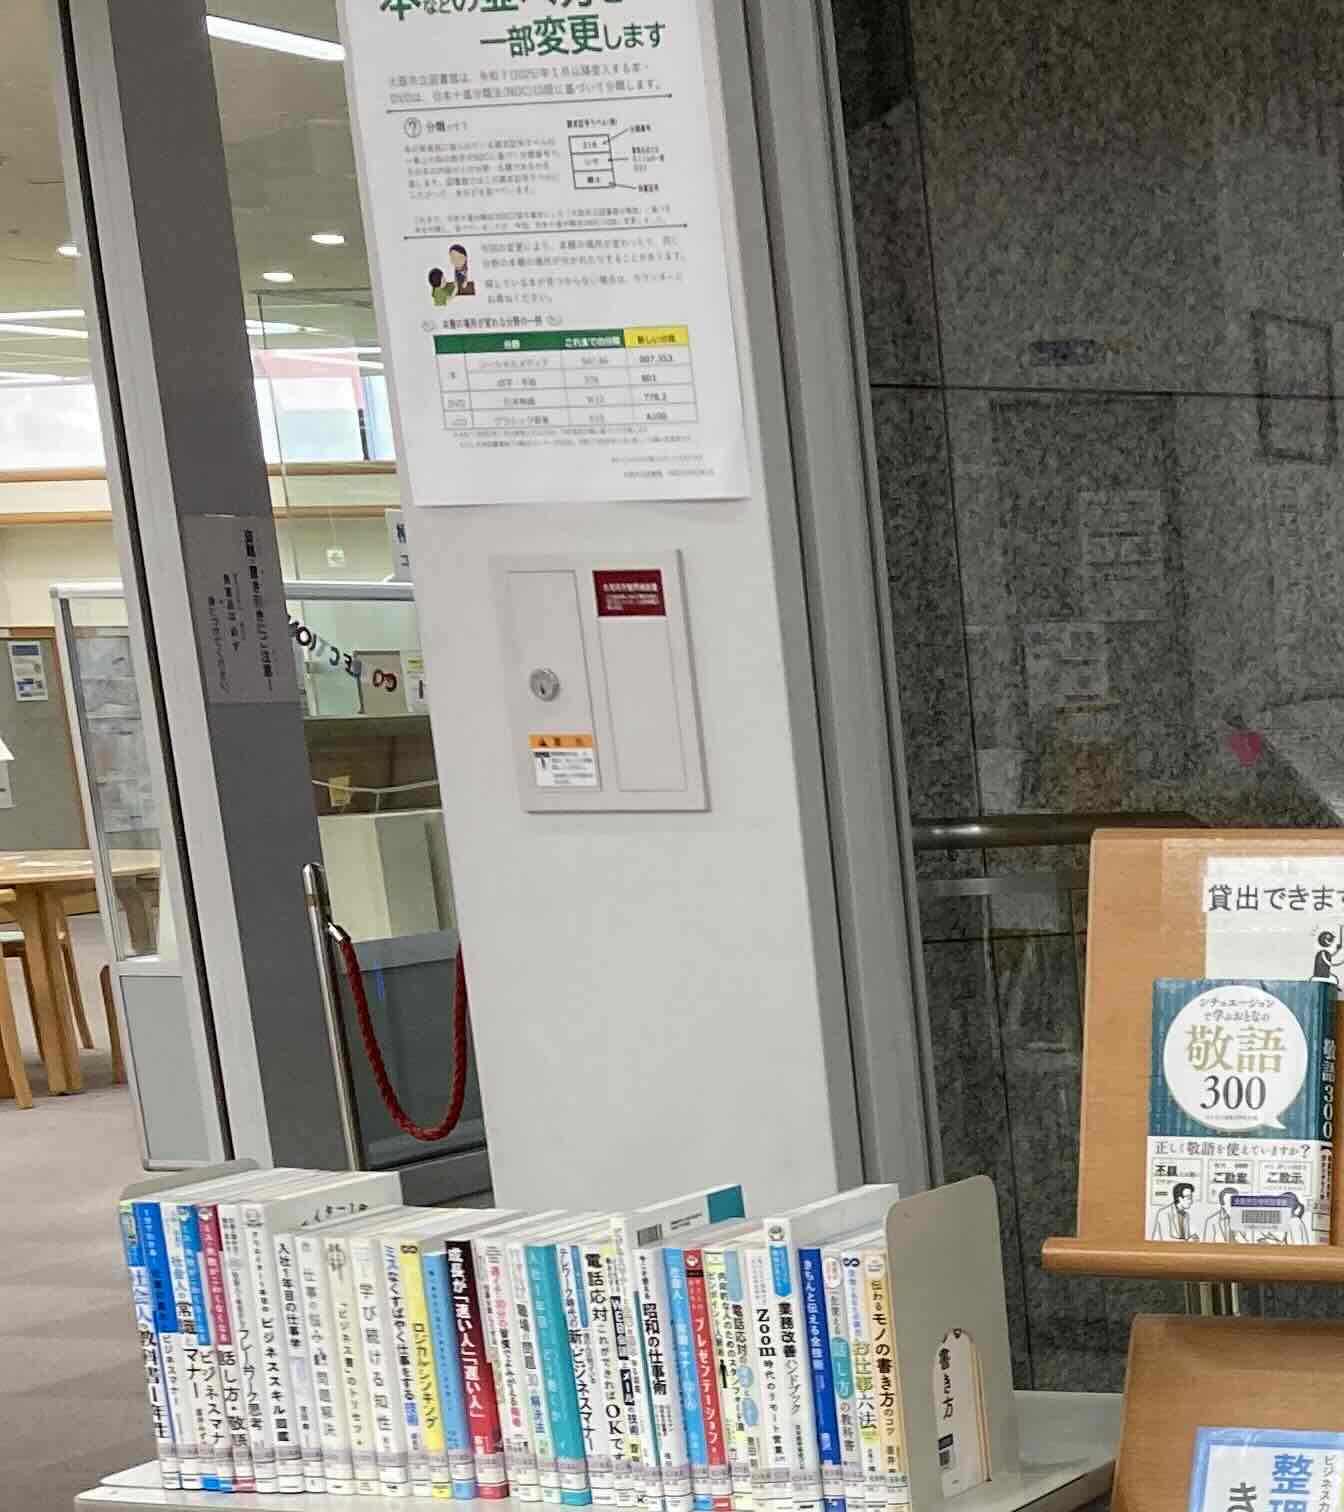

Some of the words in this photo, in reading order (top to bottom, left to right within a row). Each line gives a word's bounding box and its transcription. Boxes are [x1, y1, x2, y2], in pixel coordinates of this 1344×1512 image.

[479, 14, 666, 57] 一部変更します
[1186, 1025, 1286, 1073] 敬語
[1200, 1075, 1267, 1110] 300
[643, 1303, 667, 1396] 昭和の仕事術
